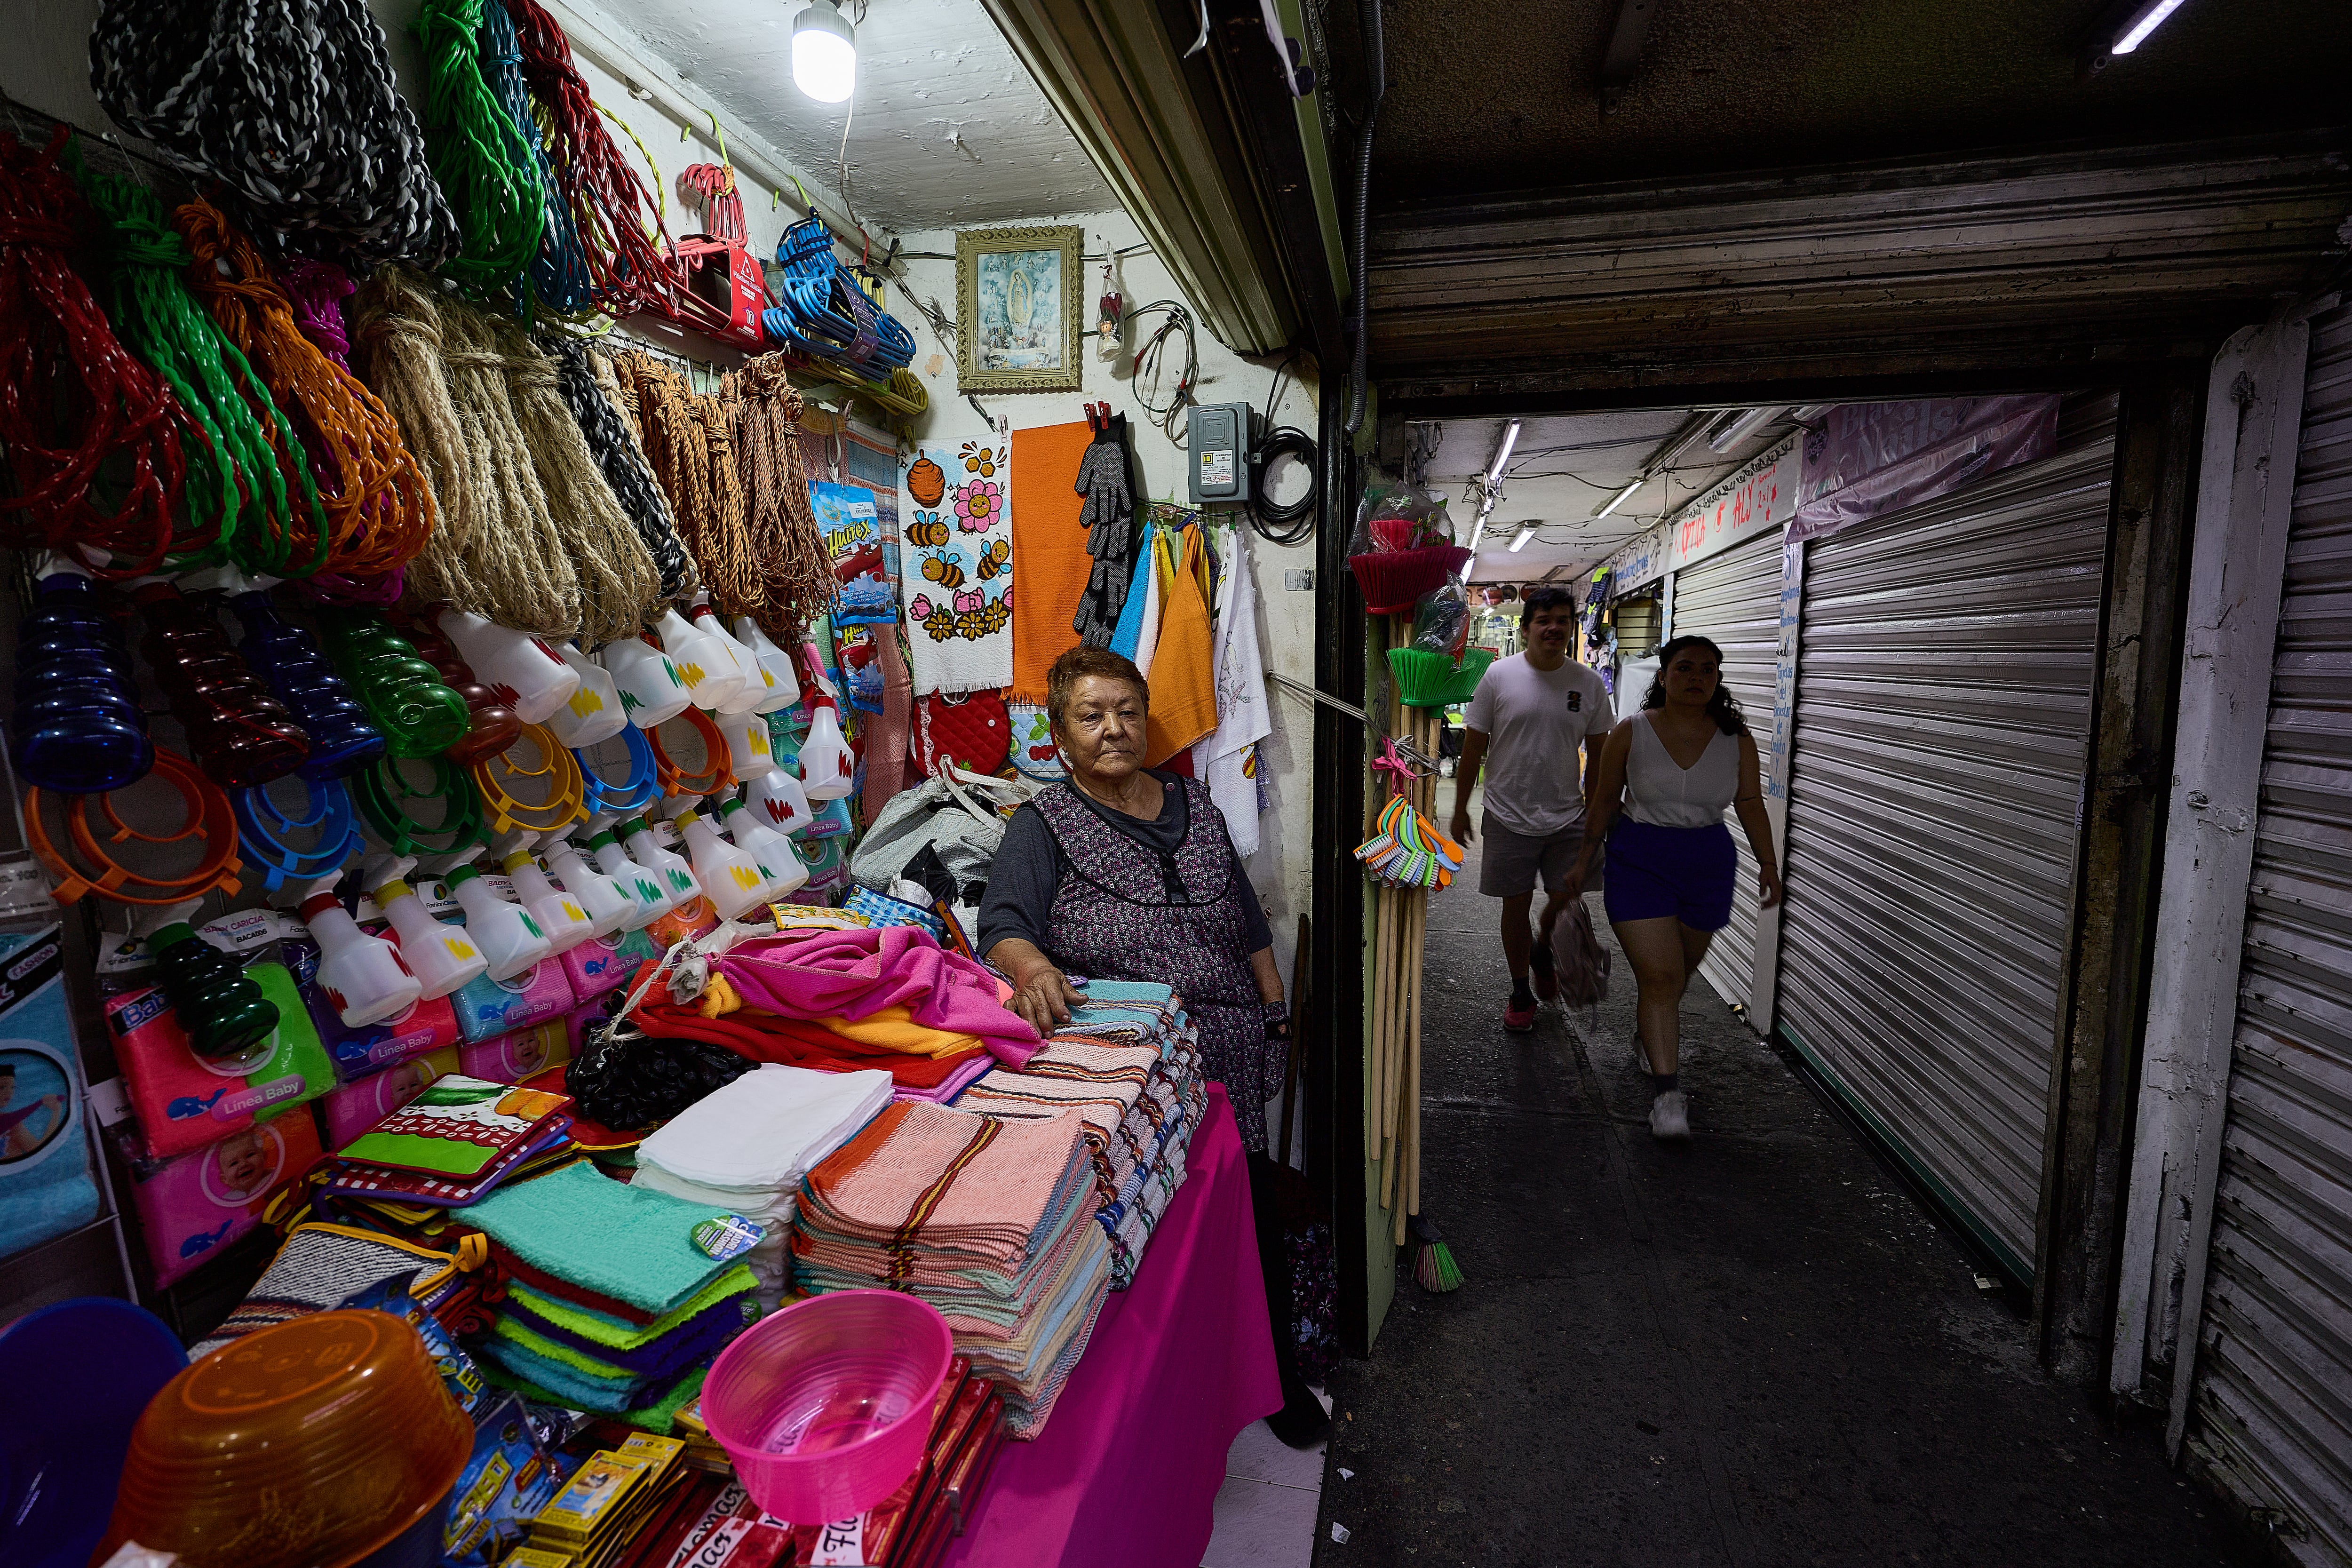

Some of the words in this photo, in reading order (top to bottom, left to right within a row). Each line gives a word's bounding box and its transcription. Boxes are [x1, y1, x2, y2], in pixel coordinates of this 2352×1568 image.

[746, 309, 755, 326] 10
[1777, 720, 1782, 735] de
[810, 823, 825, 832] Línea
[825, 822, 839, 831] Baby
[813, 875, 826, 885] Línea
[230, 915, 265, 931] CARICIA
[609, 960, 626, 974] Línea
[625, 955, 641, 968] Baby
[121, 992, 166, 1029] Bab
[511, 1008, 533, 1020] Línea
[533, 1000, 553, 1013] Baby
[377, 1043, 406, 1059] Línea
[407, 1034, 432, 1049] Baby
[223, 1093, 263, 1115] Línea
[264, 1082, 299, 1101] Baby
[696, 1226, 713, 1242] GRANDE
[708, 1227, 732, 1256] FASHION
